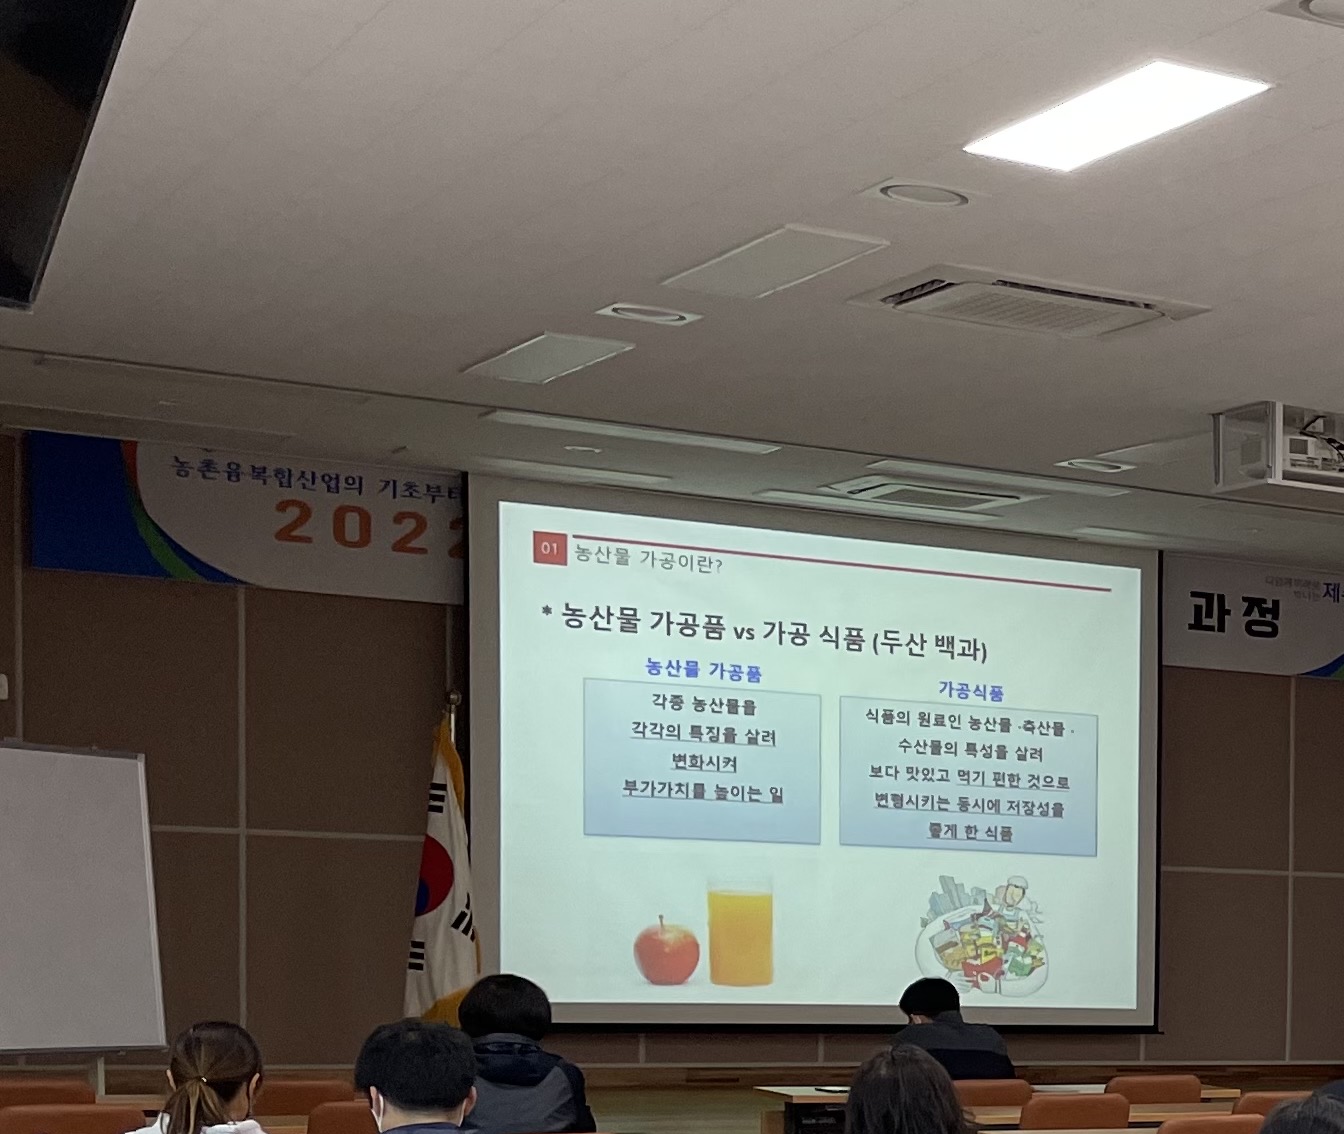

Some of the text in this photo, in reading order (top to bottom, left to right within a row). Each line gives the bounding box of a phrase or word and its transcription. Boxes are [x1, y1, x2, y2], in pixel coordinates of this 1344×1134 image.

[171, 455, 363, 496] 농촌융복합산업의
[541, 541, 723, 574] 01 농산물 가공이란?
[561, 602, 988, 664] 농산물 가공품 vs 가공 식품 (두산 백과)
[645, 657, 762, 683] 농산물 가공품
[938, 681, 1004, 702] 가공식품
[652, 693, 757, 716] 각종 농산물을
[865, 707, 911, 726] 식품의
[917, 711, 962, 730] 원료인
[968, 714, 1012, 734] 농산물
[631, 721, 681, 741] 각각의
[745, 728, 776, 747] 살려
[898, 738, 958, 757] 수산물의
[1015, 745, 1043, 762] 살려
[671, 753, 737, 773] 변화시켜
[869, 764, 900, 781] 보다
[905, 766, 951, 783] 맛있고
[957, 769, 986, 787] 먹기
[1027, 773, 1071, 791] 것으로
[622, 779, 705, 800] 부가가치를
[769, 786, 784, 804] 일
[957, 796, 1001, 814] 동시에
[964, 824, 979, 841] 한
